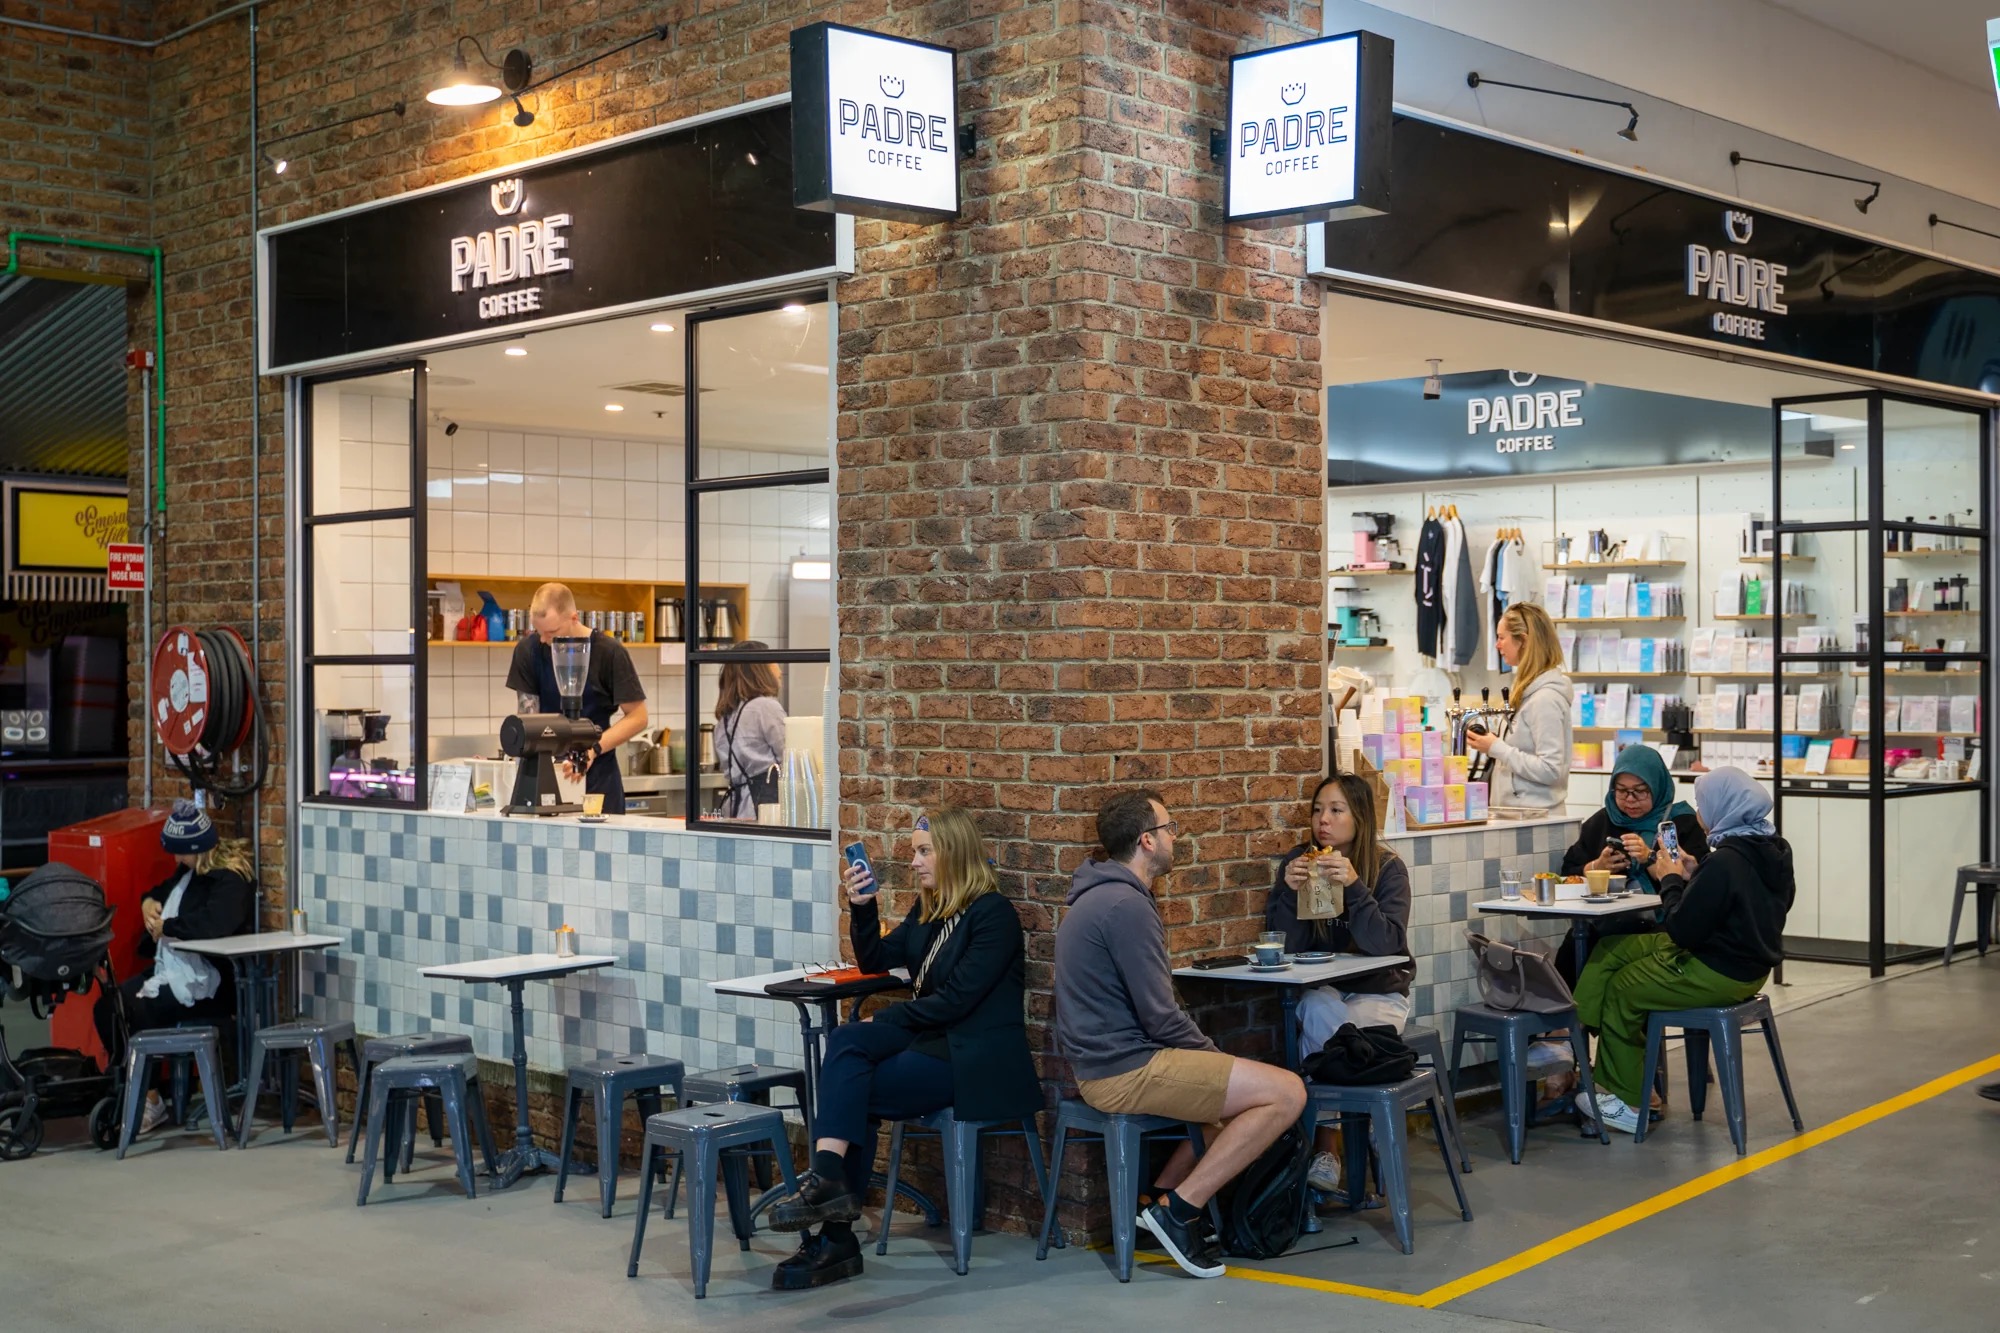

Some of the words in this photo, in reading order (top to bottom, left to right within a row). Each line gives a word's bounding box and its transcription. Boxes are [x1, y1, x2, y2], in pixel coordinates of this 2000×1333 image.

[839, 98, 948, 153] PADRE
[1240, 106, 1348, 158] PADRE
[868, 149, 922, 171] COFFEE
[1265, 155, 1319, 176] COFFEE
[450, 213, 573, 293] PADRE
[1687, 243, 1789, 316] PADRE
[478, 287, 543, 320] COFFEE
[1712, 311, 1766, 341] COFFEE
[1467, 389, 1584, 435] PADRE
[1495, 434, 1556, 453] COFFEE
[75, 504, 128, 538] Emera
[110, 552, 121, 563] FIRE
[122, 553, 144, 563] HYDRAN
[111, 571, 128, 581] HOSE
[129, 572, 145, 582] REEL
